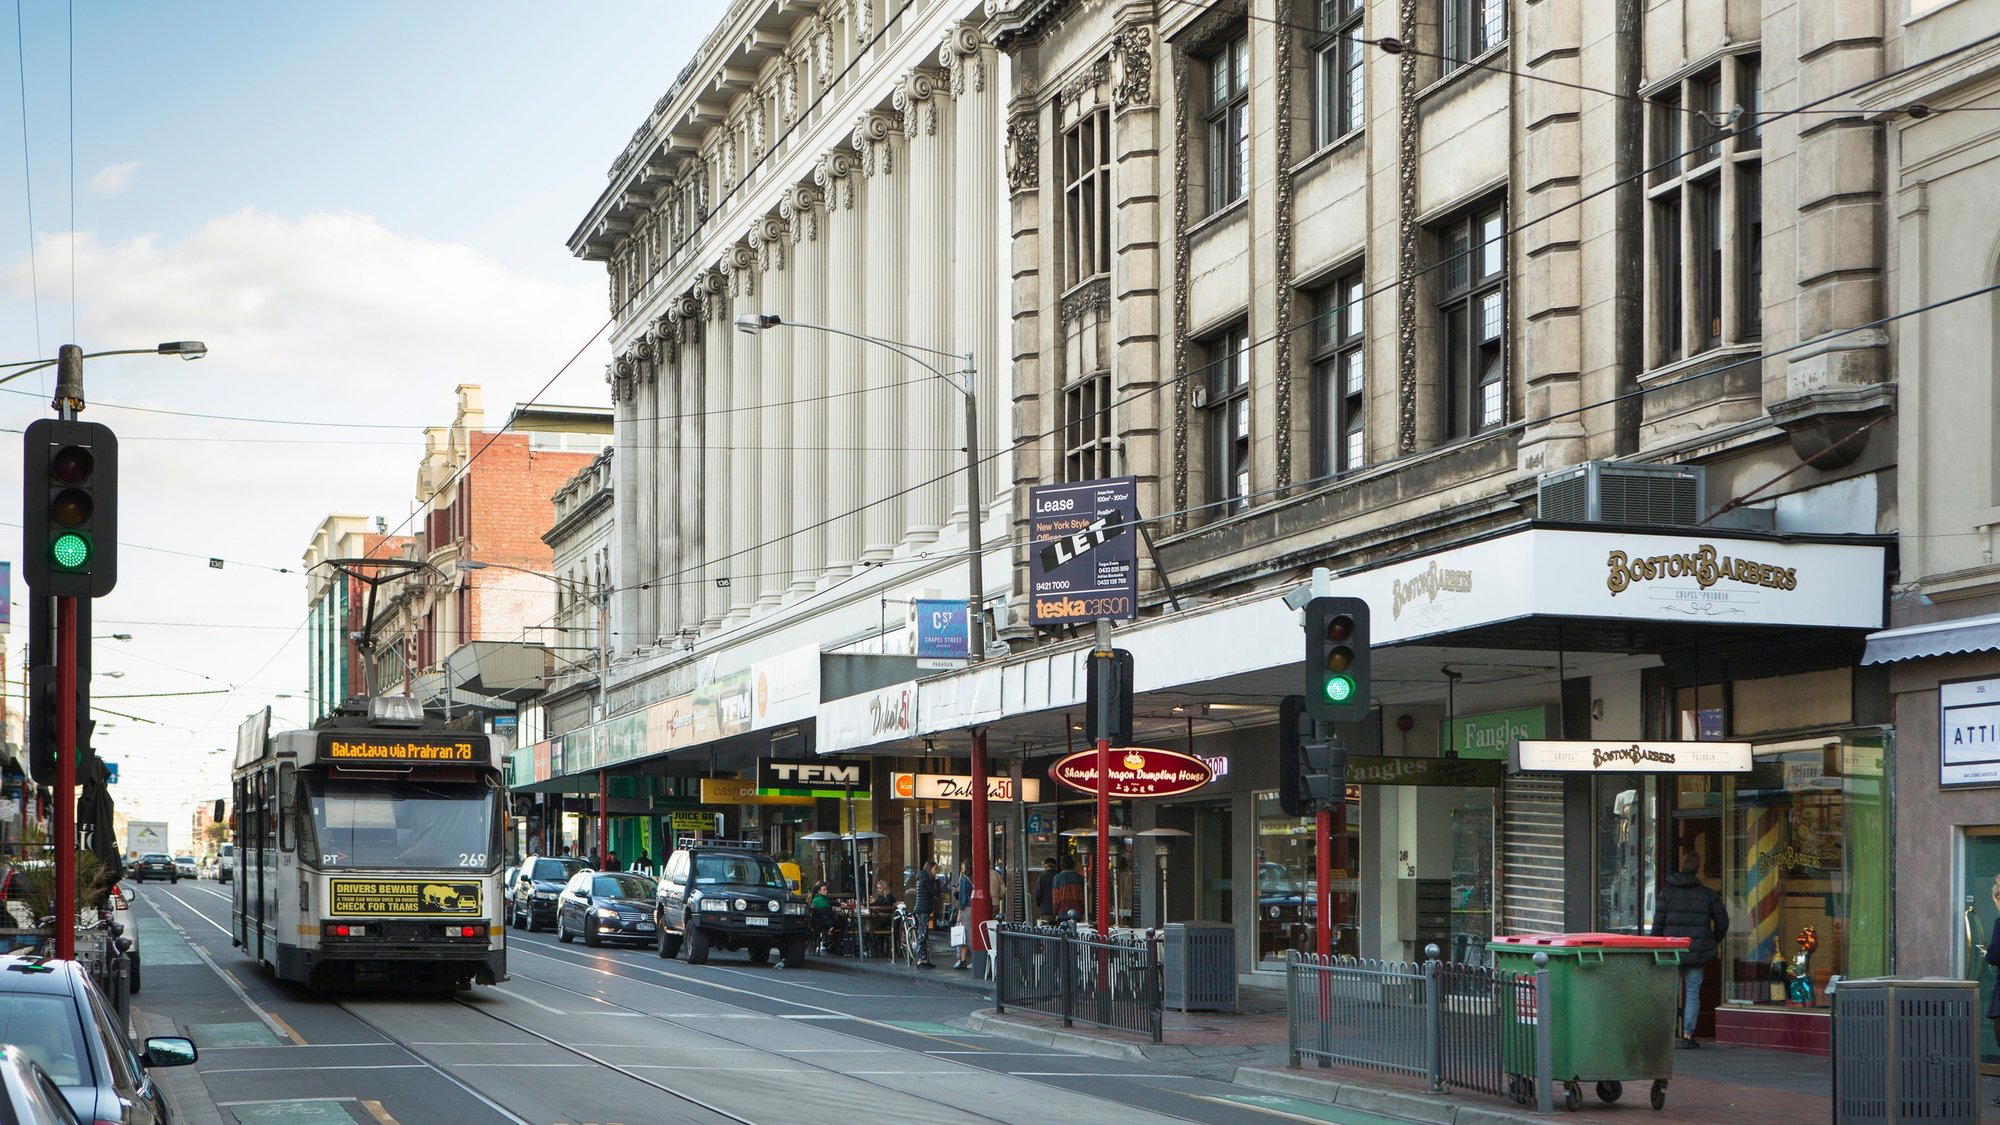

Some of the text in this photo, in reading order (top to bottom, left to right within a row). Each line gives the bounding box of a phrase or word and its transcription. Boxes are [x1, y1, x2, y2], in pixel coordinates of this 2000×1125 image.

[1036, 498, 1074, 513] Lease
[1036, 519, 1089, 531] New York Style
[1054, 518, 1106, 565] LET
[1036, 581, 1070, 591] 9421 7000
[944, 636, 962, 644] STREET
[1464, 719, 1528, 751] Fangles
[1954, 724, 2000, 745] ATTI
[331, 741, 472, 760] Balaclava via Prahran 78
[770, 763, 860, 781] TFM
[1064, 767, 1098, 779] Shangha
[1136, 769, 1177, 783] Dumpling
[1178, 770, 1205, 781] House
[713, 784, 757, 797] cashco
[673, 812, 715, 821] JUICE BA
[459, 853, 486, 867] 269
[336, 884, 419, 895] DRIVERS BEWARE
[336, 902, 419, 912] CHECK FOR TRAMS
